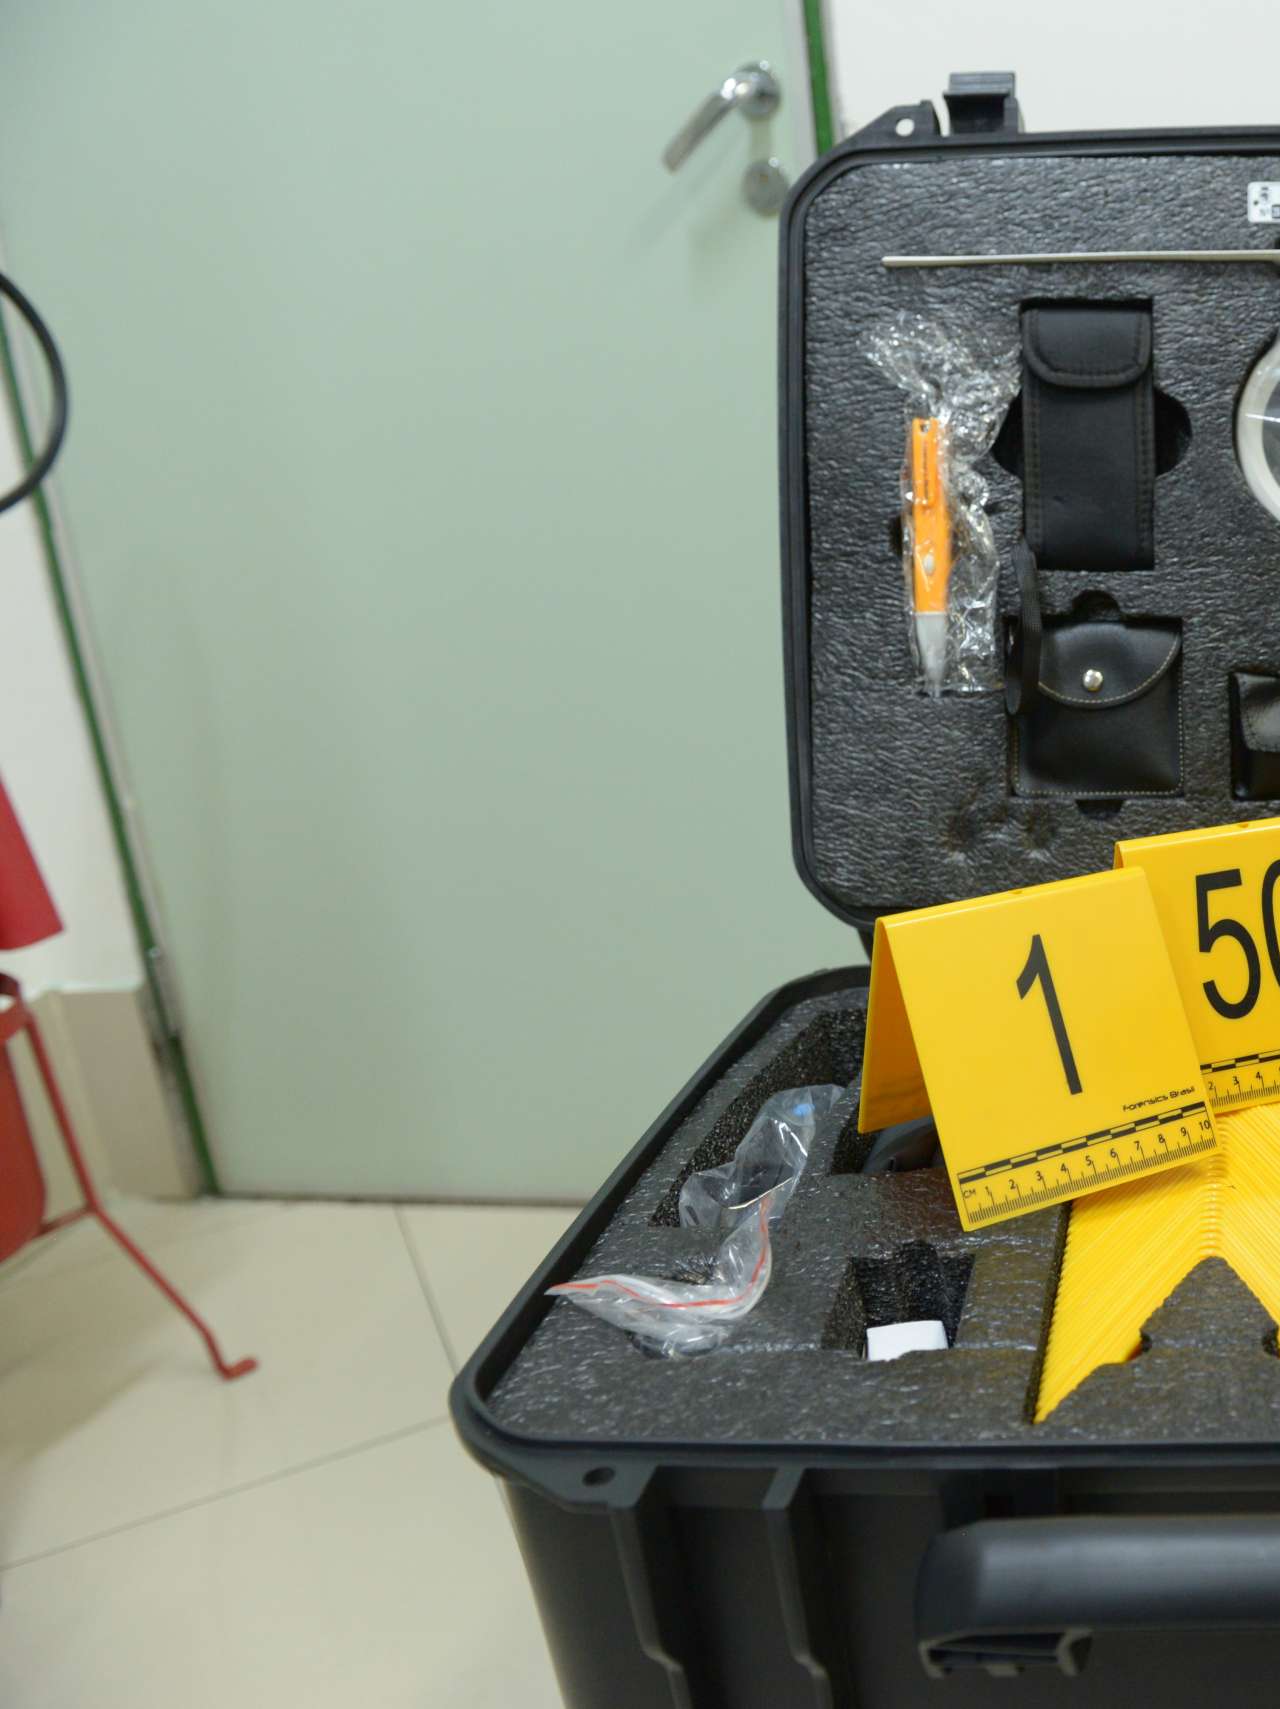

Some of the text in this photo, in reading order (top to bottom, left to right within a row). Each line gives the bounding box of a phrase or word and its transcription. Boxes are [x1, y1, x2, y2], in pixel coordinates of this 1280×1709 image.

[1015, 933, 1083, 1096] 1
[1122, 1086, 1196, 1113] Forensics Brasil
